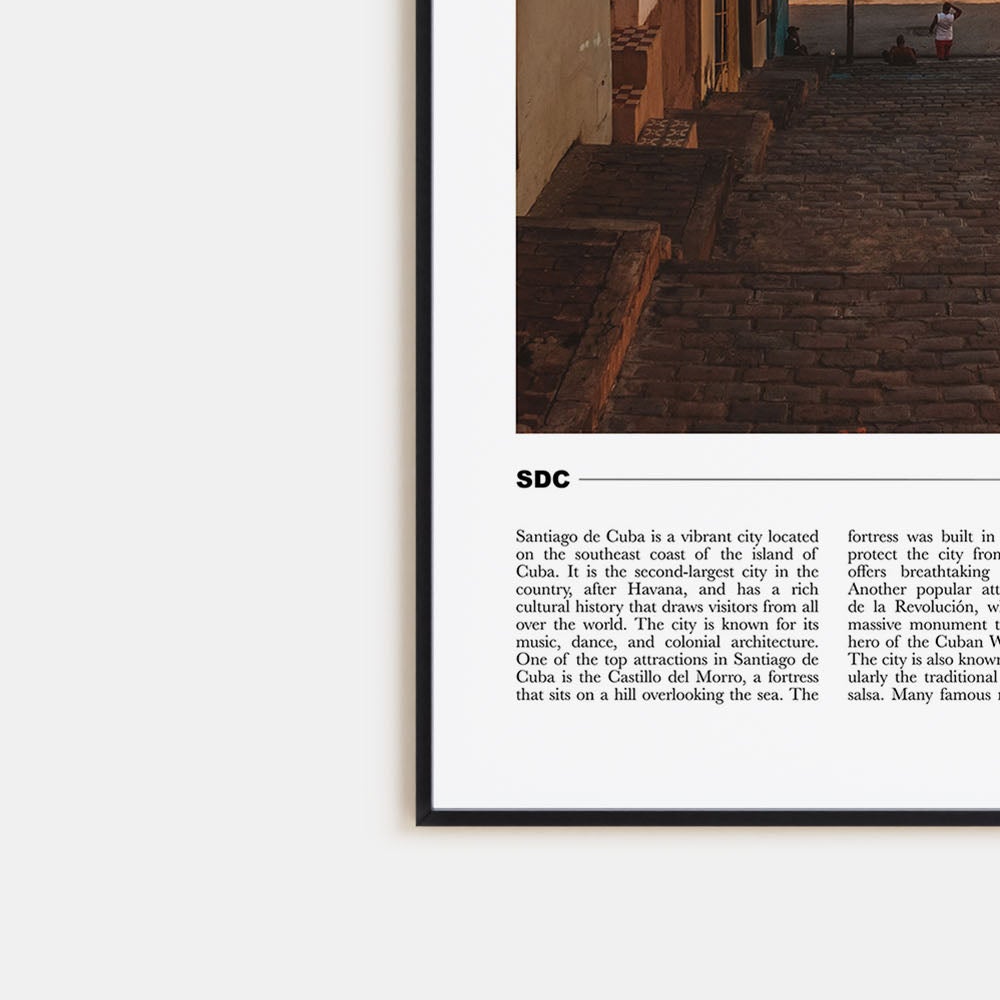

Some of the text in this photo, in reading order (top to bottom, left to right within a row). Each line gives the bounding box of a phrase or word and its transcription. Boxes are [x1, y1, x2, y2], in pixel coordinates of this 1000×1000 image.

[516, 470, 571, 489] SDC
[516, 530, 818, 546] Santiago de Cuba is a vibrant city located
[849, 530, 898, 543] fortress
[907, 534, 933, 542] was
[942, 530, 973, 542] built
[982, 530, 994, 542] in
[516, 565, 818, 581] Cuba. It is the second-largest city in the
[848, 565, 886, 577] offers
[901, 565, 990, 581] breathtaking
[516, 600, 818, 616] cultural history that draws visitors from all
[848, 600, 864, 613] de
[874, 600, 886, 612] la
[895, 600, 978, 615] Revolución,
[848, 618, 901, 630] massive
[910, 621, 987, 630] monument
[517, 635, 818, 650] music, dance, and colonial architecture.
[516, 653, 818, 669] One of the top attractions in Santiago de
[848, 653, 877, 665] The
[882, 653, 907, 669] city
[912, 653, 922, 665] is
[927, 653, 953, 665] also
[517, 670, 819, 686] Cuba is the Castillo del Morro, a fortress
[848, 670, 888, 687] ularly
[896, 670, 917, 683] the
[925, 670, 997, 683] traditional
[517, 688, 818, 704] that sits on a hill overlooking the sea. The
[848, 688, 883, 700] salsa.
[892, 688, 933, 704] Many
[941, 688, 991, 700] famous
